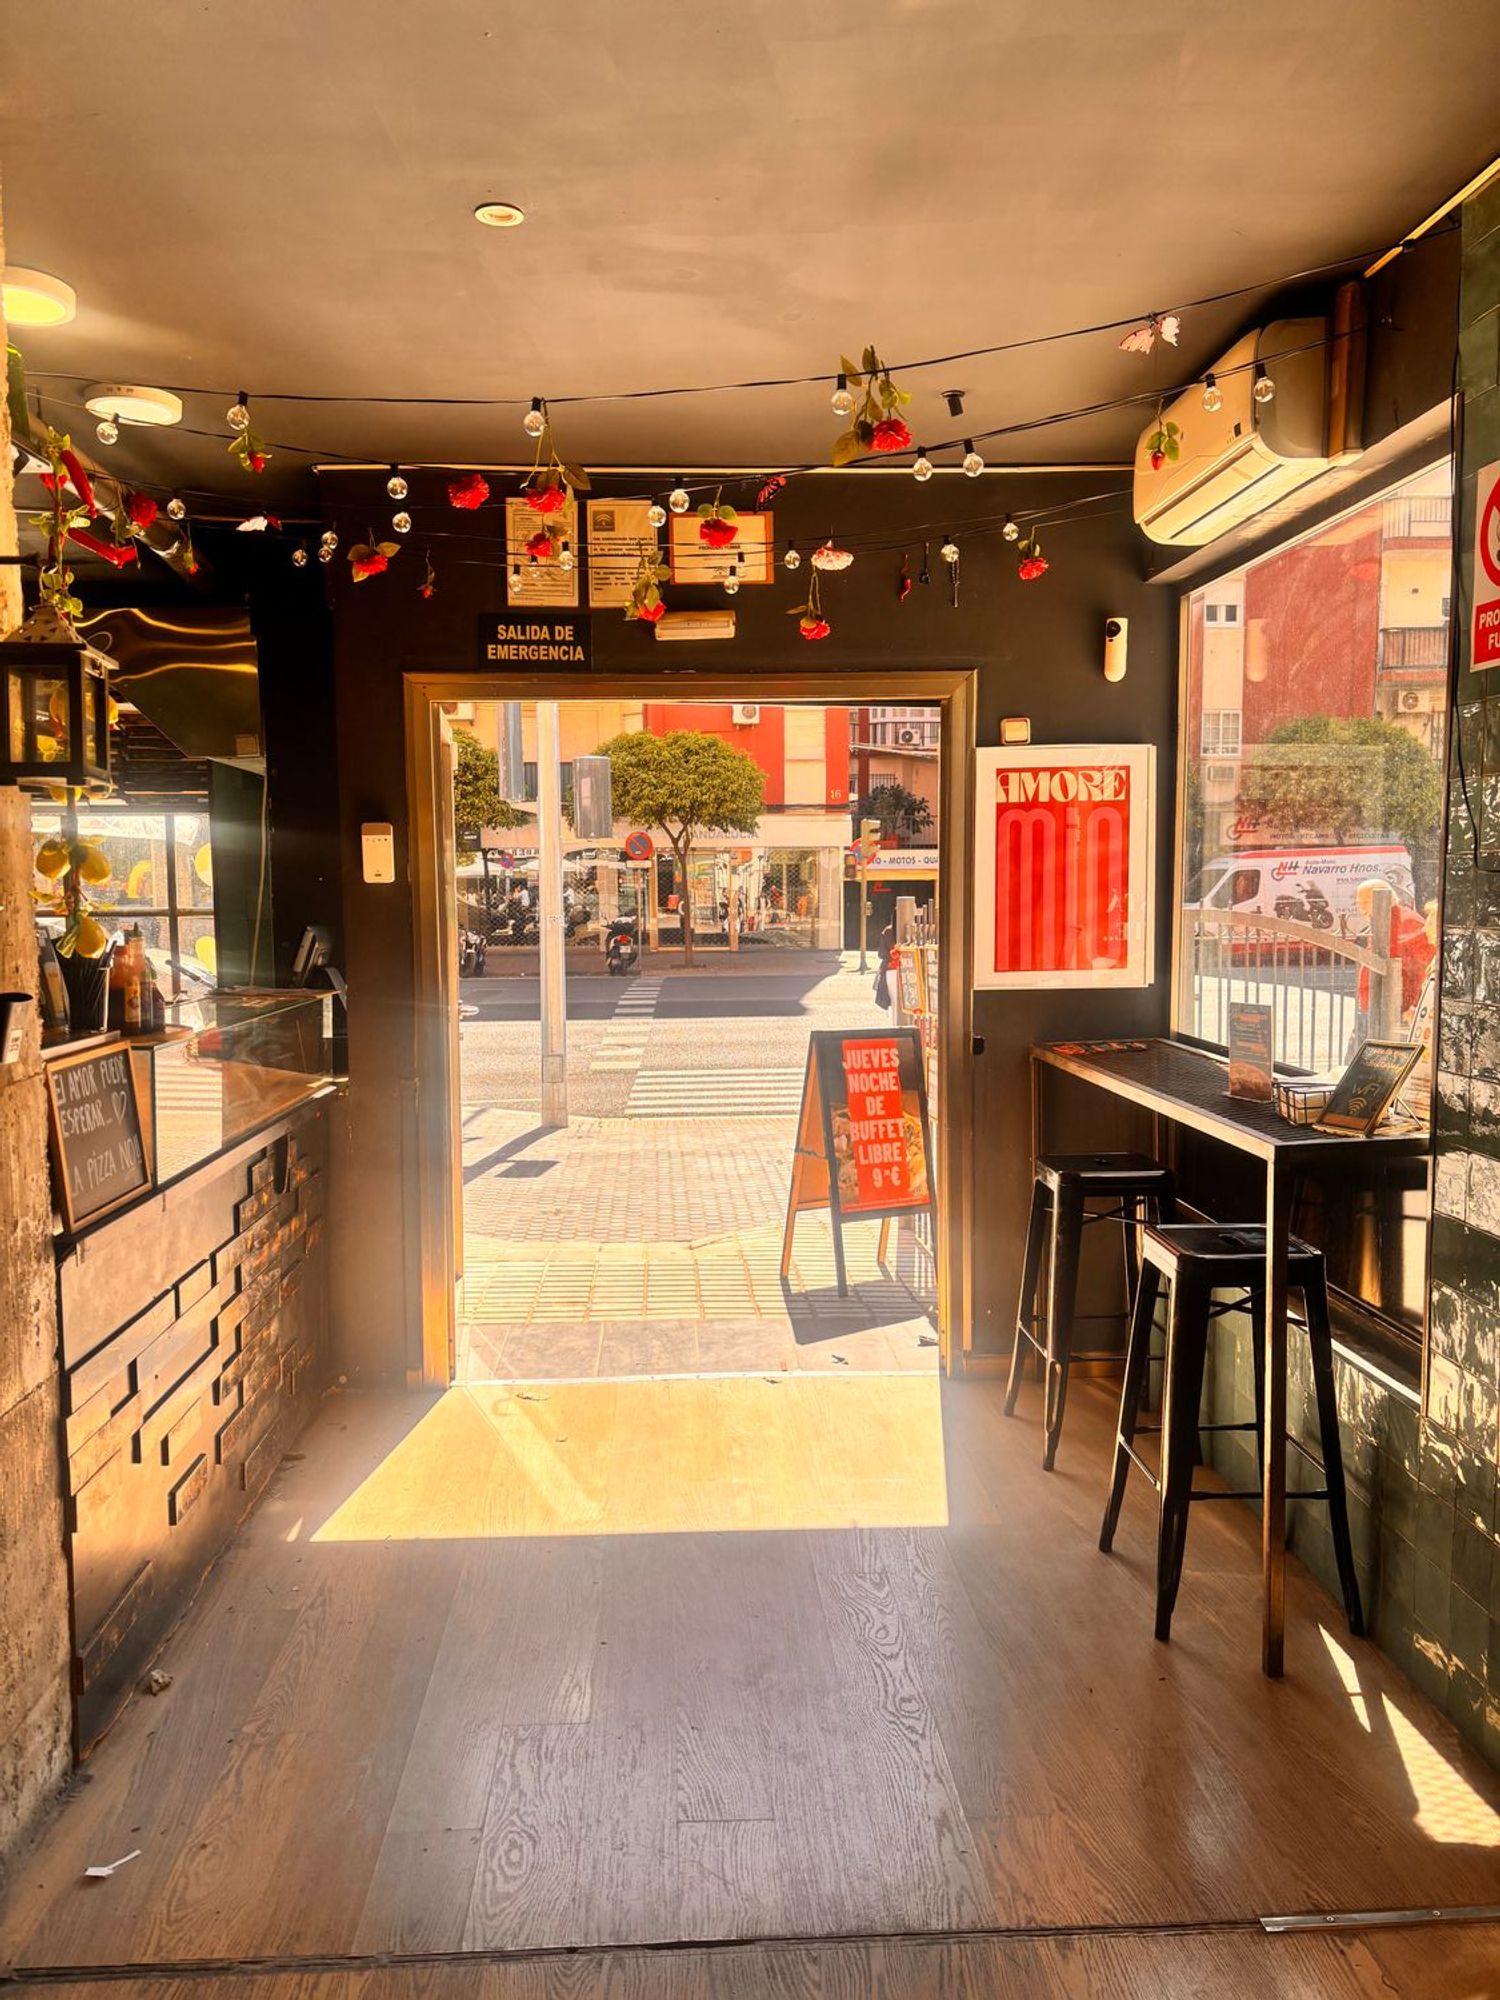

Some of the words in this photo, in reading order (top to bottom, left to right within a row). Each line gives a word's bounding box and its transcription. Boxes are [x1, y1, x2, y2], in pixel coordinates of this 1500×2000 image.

[497, 624, 550, 641] SALIDA
[554, 625, 574, 641] DE
[487, 644, 585, 661] EMERGENCIA
[996, 769, 1127, 803] AMORE
[888, 857, 916, 865] MOTOS
[1302, 864, 1347, 875] Navarro
[1349, 862, 1382, 874] Hnos.
[842, 1047, 900, 1070] JUEVES
[68, 1064, 98, 1102] AMOR
[847, 1071, 899, 1094] NOCHE
[865, 1095, 886, 1116] DE
[850, 1117, 905, 1142] BUFFET
[858, 1142, 902, 1165] LIBRE
